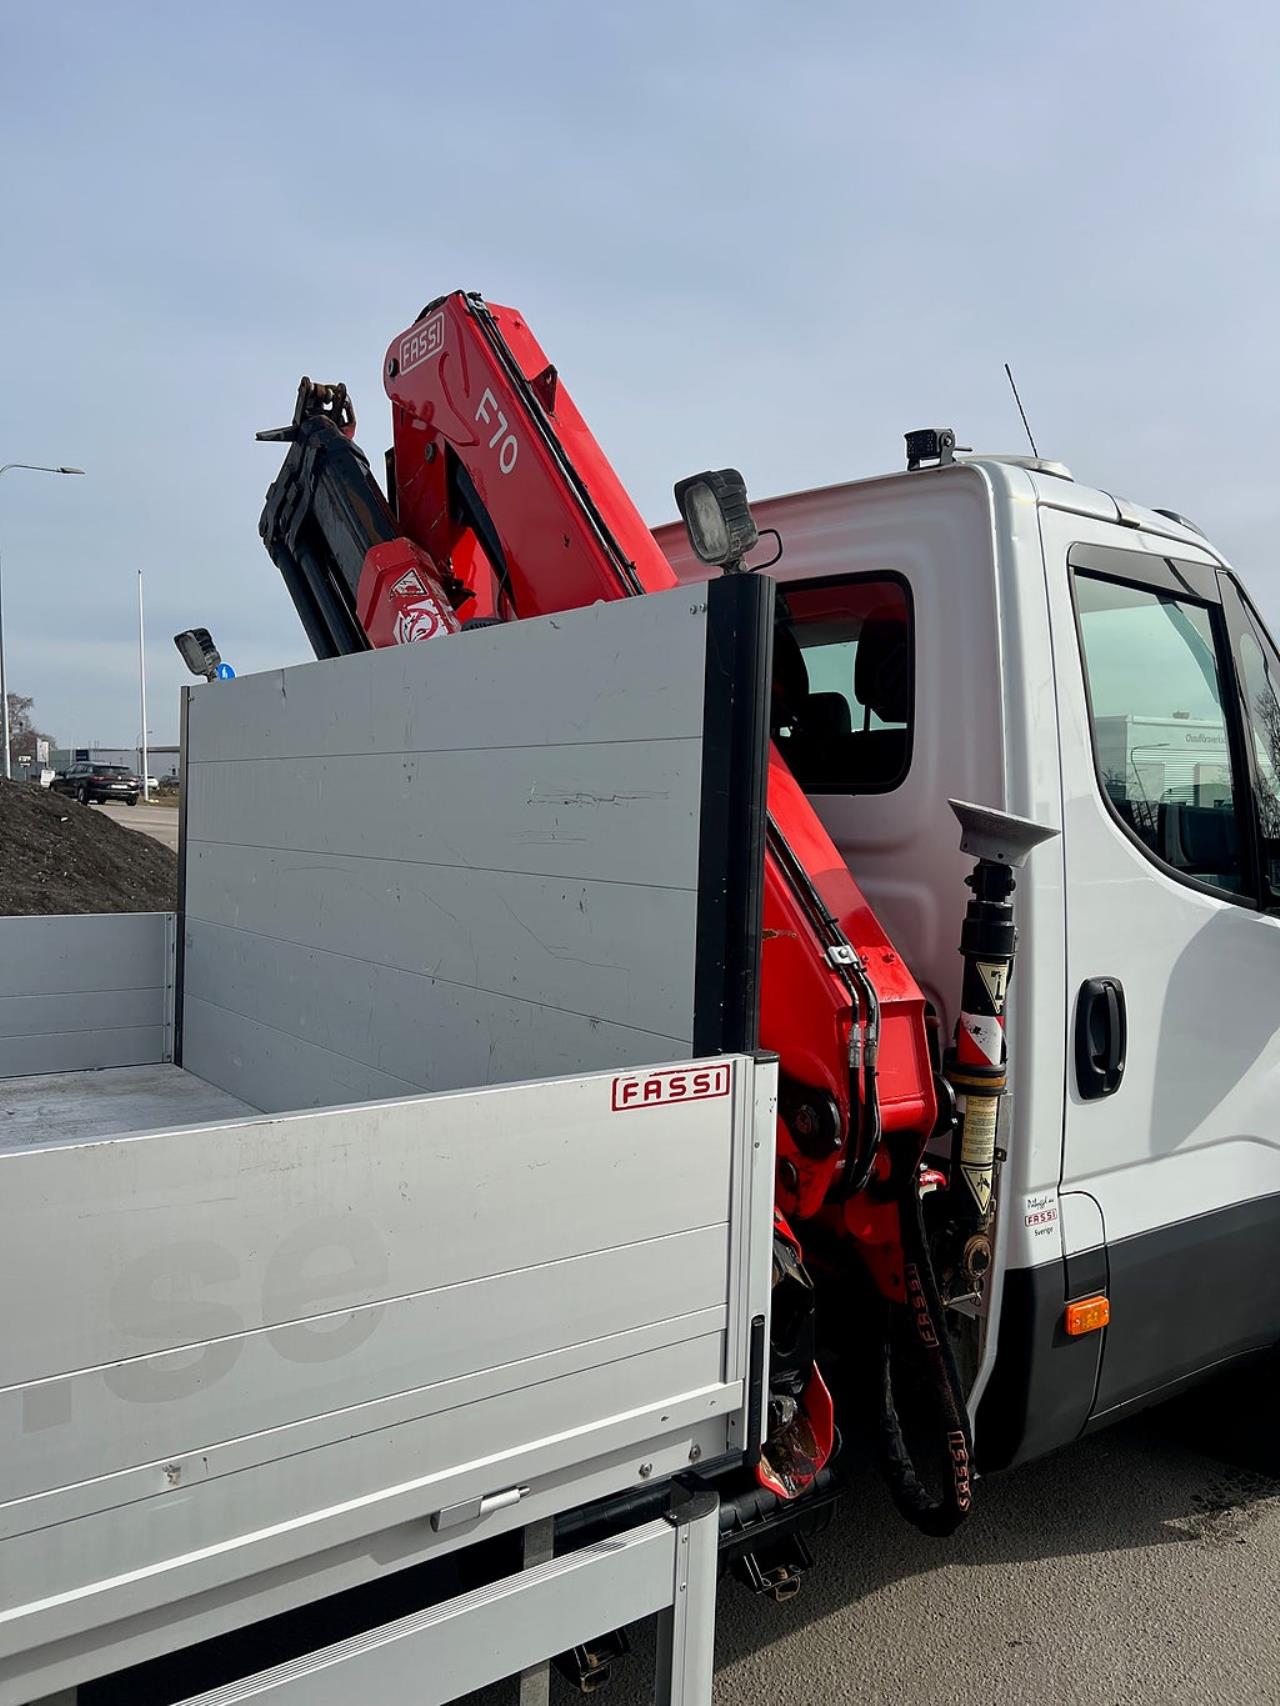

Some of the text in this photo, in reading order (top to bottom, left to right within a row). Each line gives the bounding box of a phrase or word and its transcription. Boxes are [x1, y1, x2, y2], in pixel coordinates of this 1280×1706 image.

[402, 321, 441, 367] FASSI
[622, 1071, 721, 1104] FASSI
[1027, 1210, 1056, 1225] FASSI
[907, 1269, 936, 1343] FASSI
